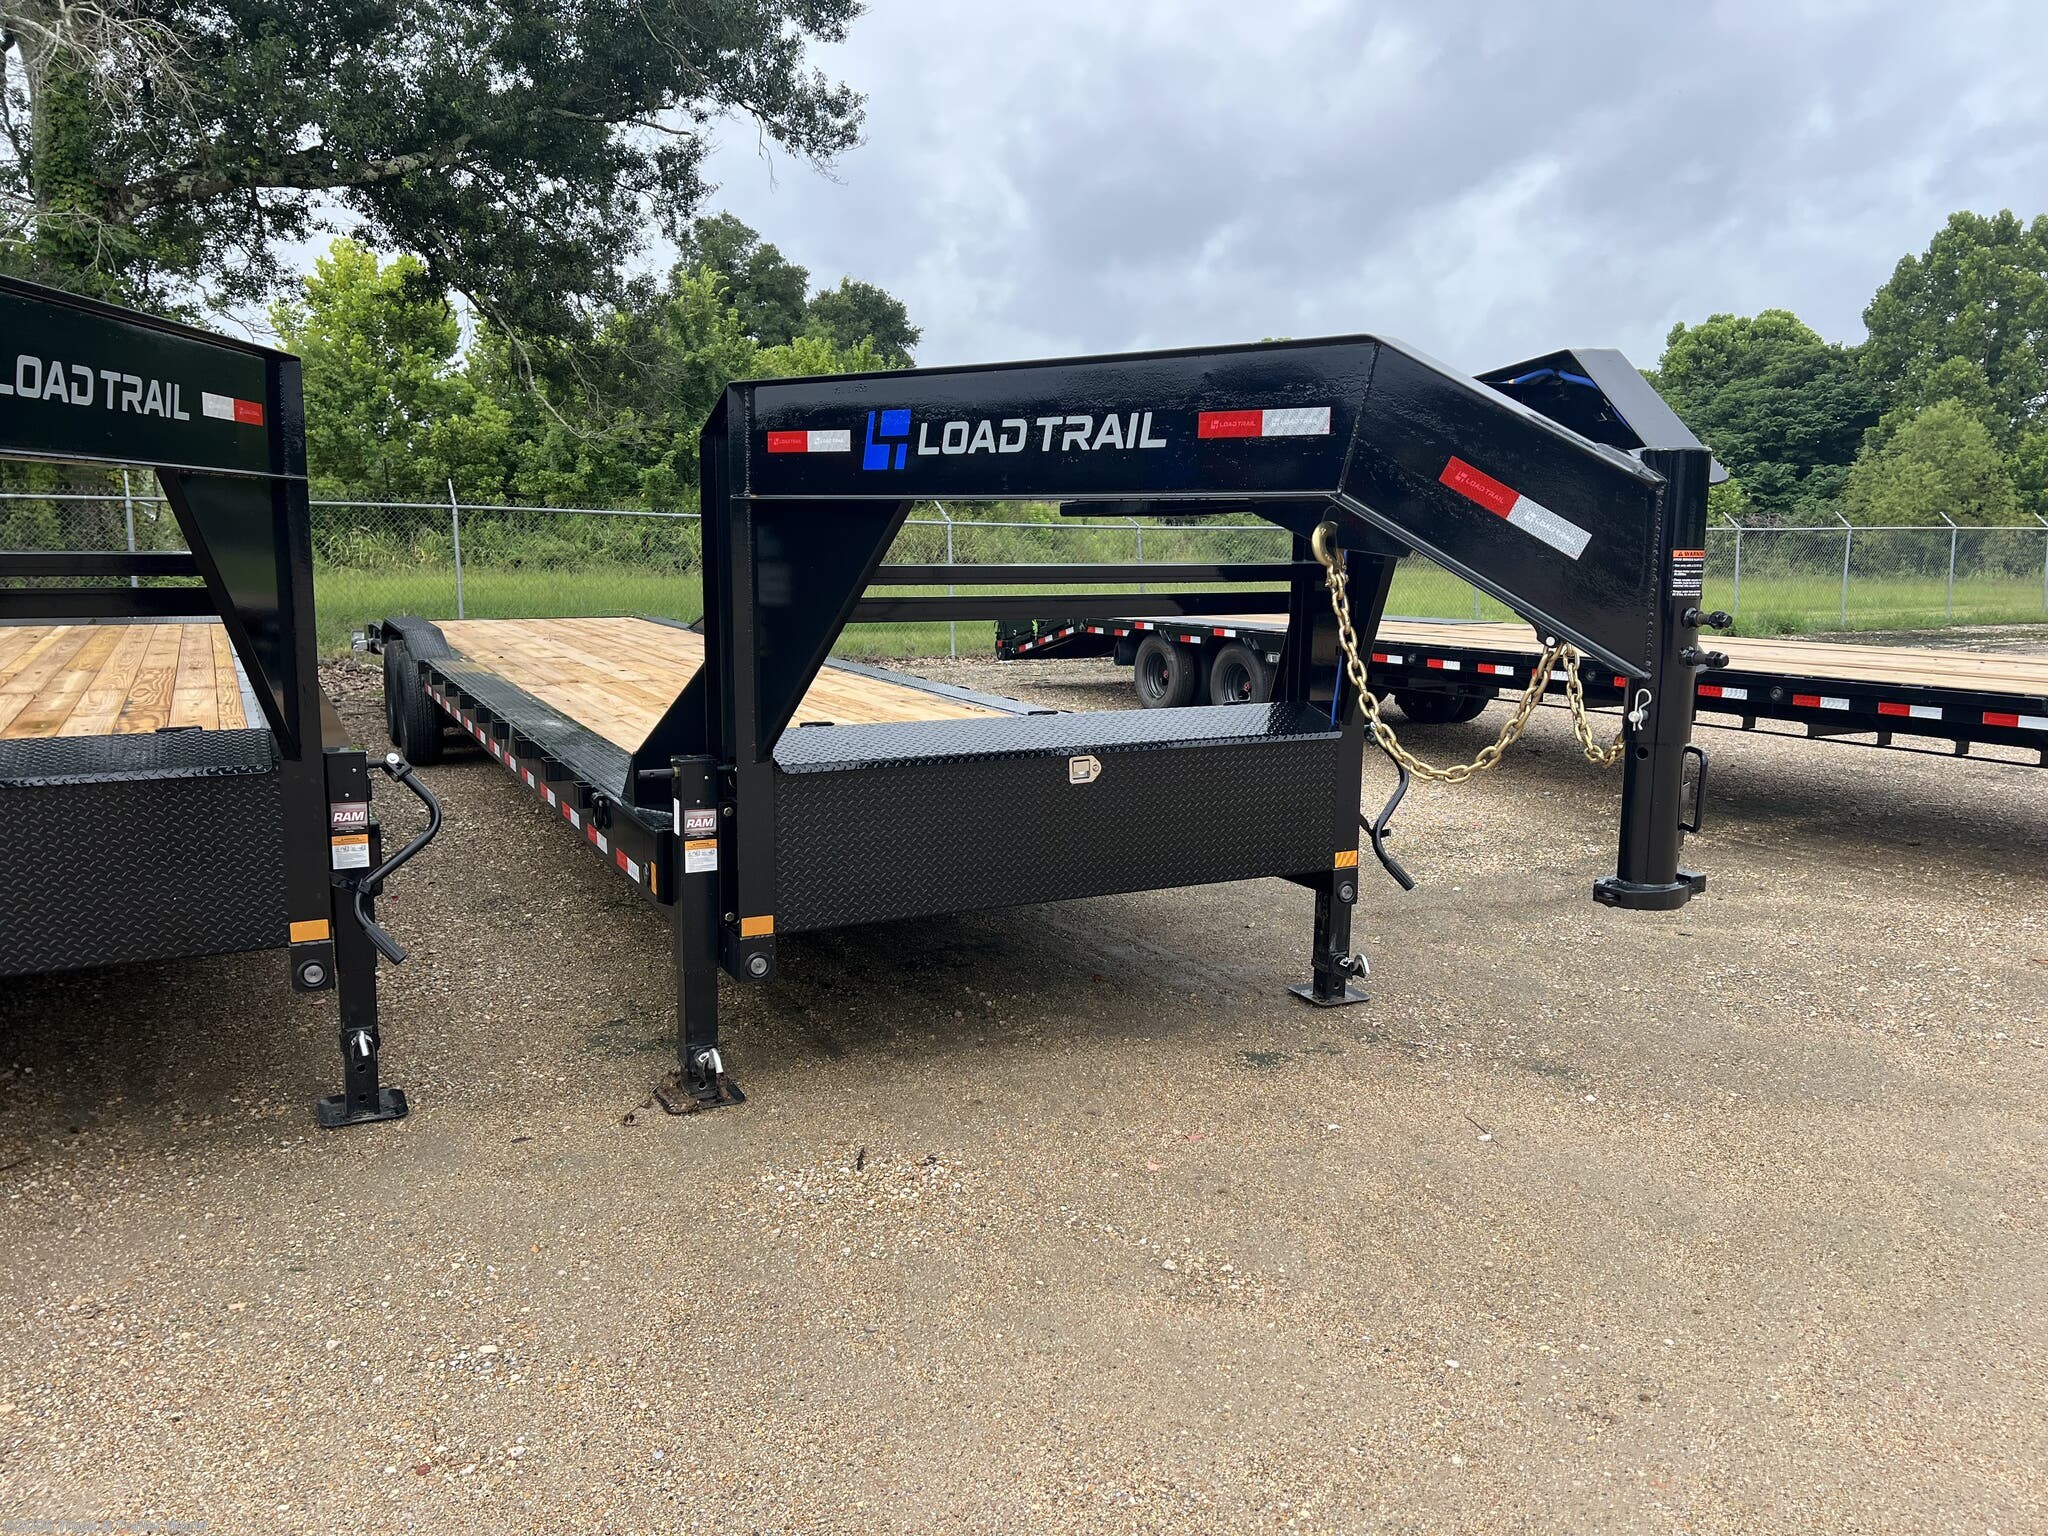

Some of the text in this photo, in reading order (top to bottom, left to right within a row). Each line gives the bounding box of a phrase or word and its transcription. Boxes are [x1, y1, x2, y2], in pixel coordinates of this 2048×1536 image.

[100, 369, 190, 421] TRAIL
[918, 411, 1167, 455] LOAD TRAIL
[333, 811, 364, 823] RAM
[686, 819, 714, 828] RAM
